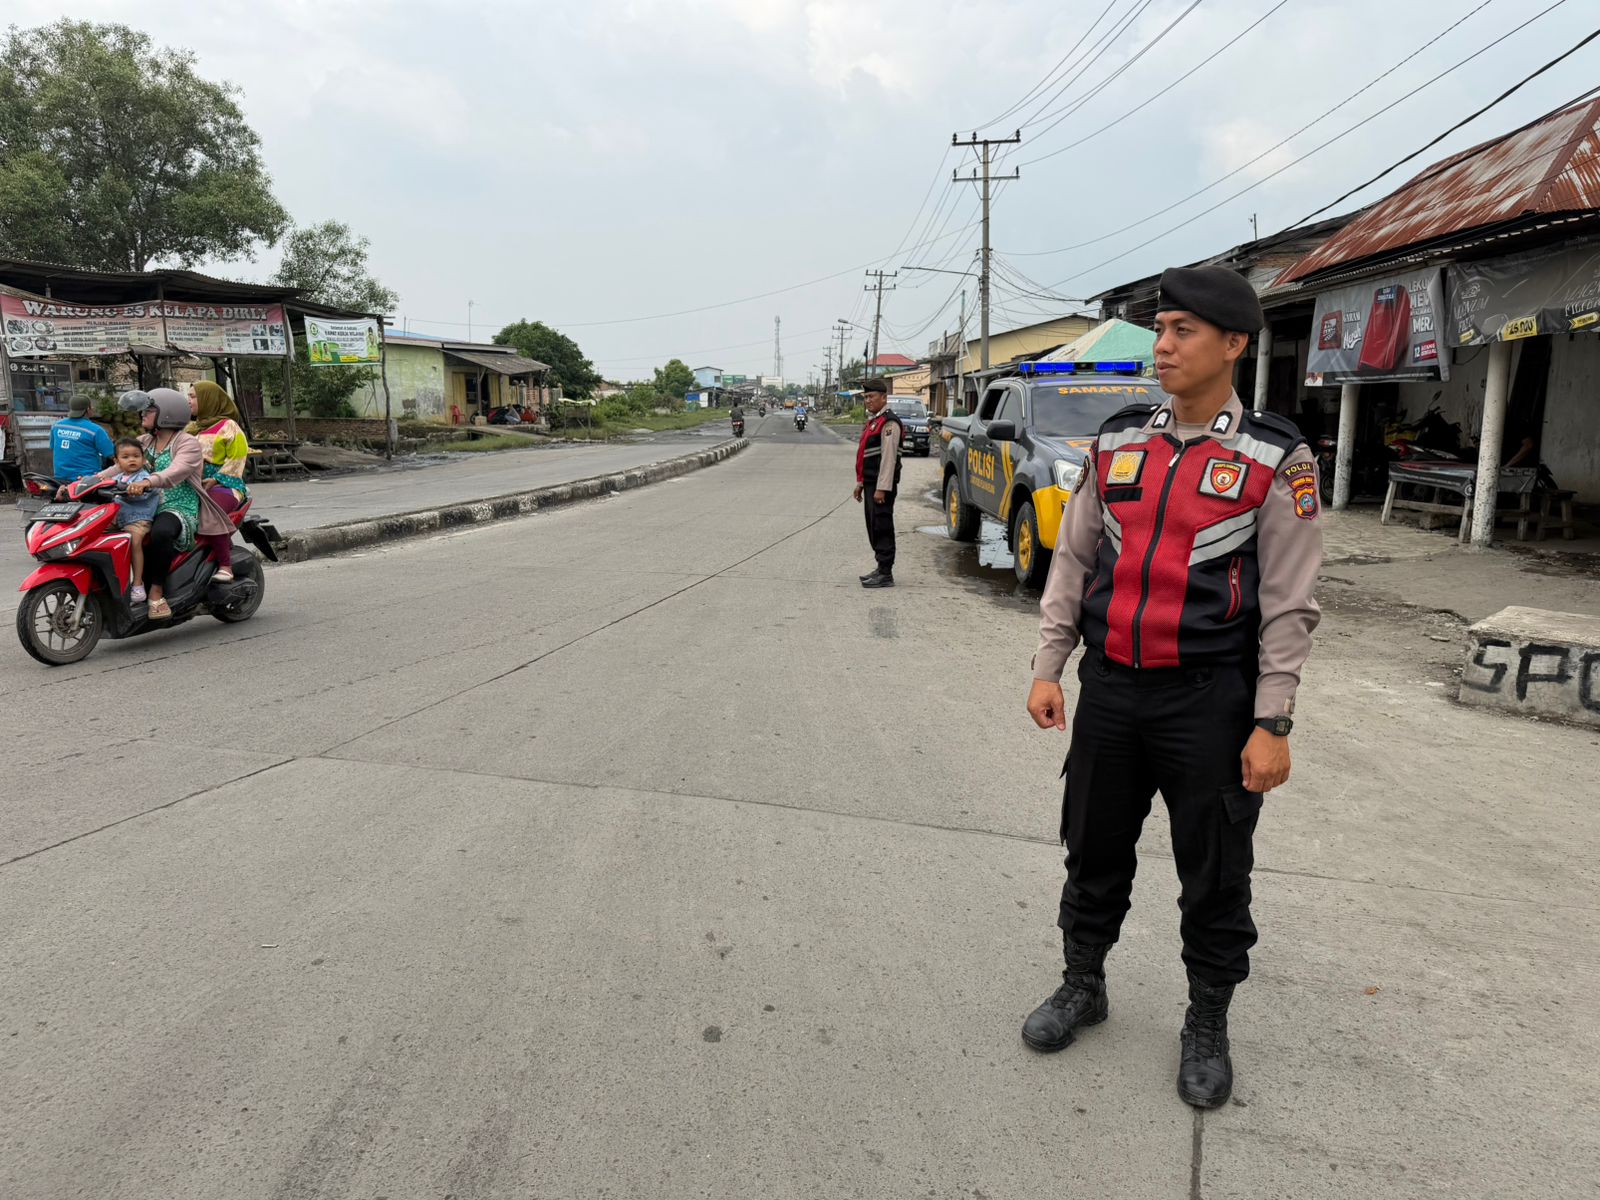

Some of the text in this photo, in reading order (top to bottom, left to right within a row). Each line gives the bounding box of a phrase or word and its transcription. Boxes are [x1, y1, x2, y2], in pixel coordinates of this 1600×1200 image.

[22, 300, 118, 317] WARUNG
[149, 305, 219, 318] KELAPA
[1058, 386, 1149, 395] SAMAPTA
[967, 447, 995, 481] POLISI
